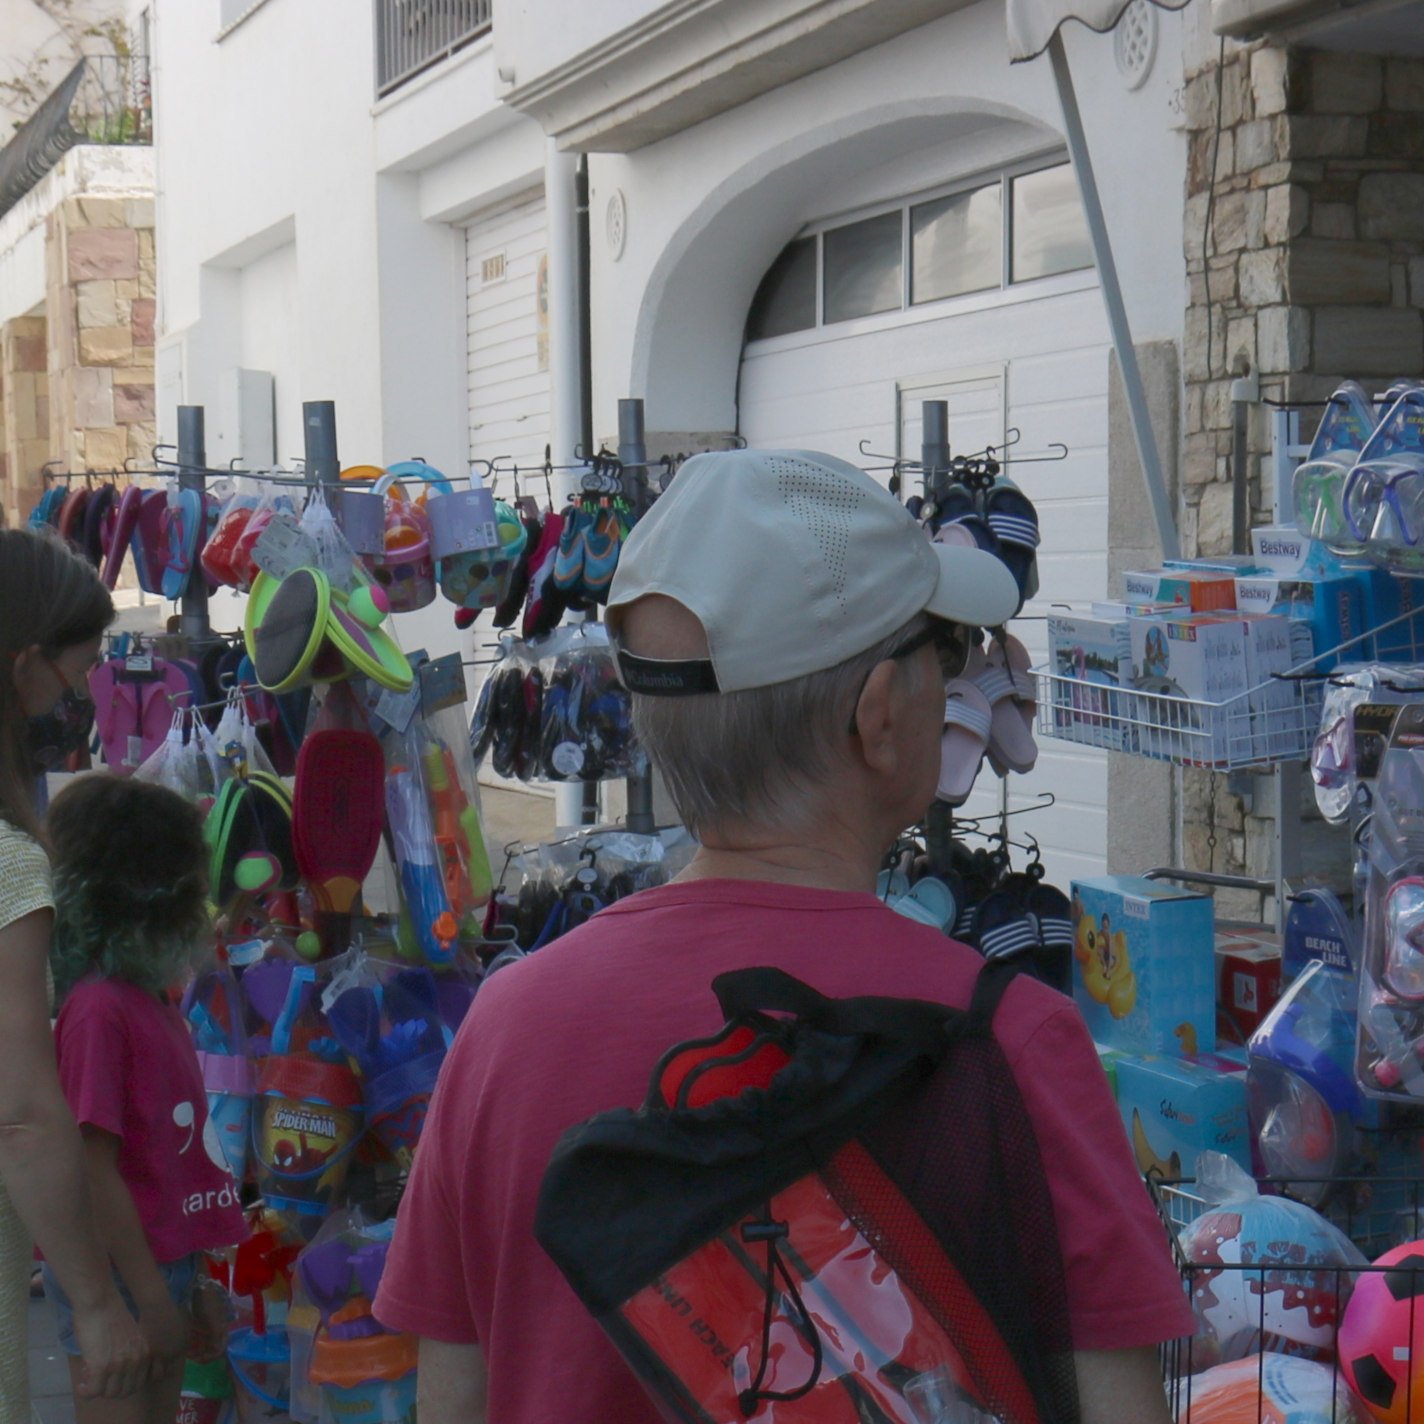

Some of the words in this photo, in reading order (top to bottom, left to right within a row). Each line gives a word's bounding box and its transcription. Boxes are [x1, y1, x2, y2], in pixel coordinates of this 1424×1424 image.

[1260, 538, 1302, 560] Bestway
[1125, 576, 1154, 595] Bestway
[1239, 585, 1271, 601] Bestway
[630, 669, 684, 689] Columbia
[1304, 936, 1341, 952] BEACH
[1322, 950, 1348, 967] LINE
